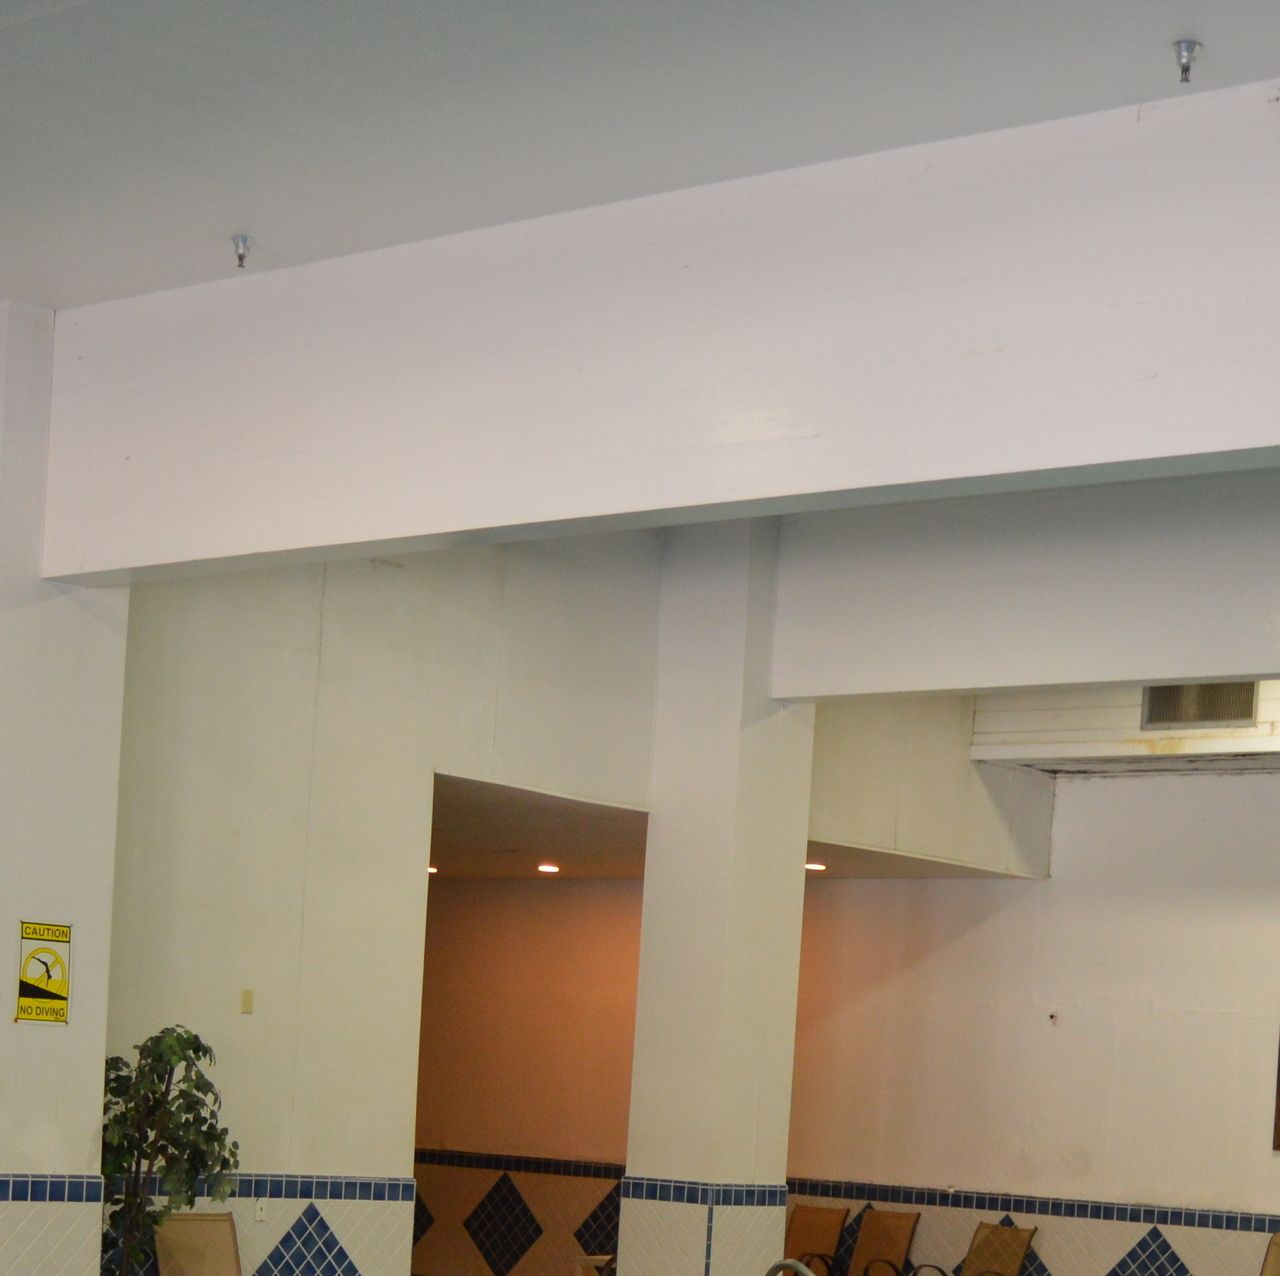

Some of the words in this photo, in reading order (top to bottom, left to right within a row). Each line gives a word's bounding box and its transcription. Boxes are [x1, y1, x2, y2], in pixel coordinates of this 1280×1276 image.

[24, 926, 68, 939] CAUTION
[20, 1005, 33, 1016] NO
[35, 1006, 65, 1018] DIVING
